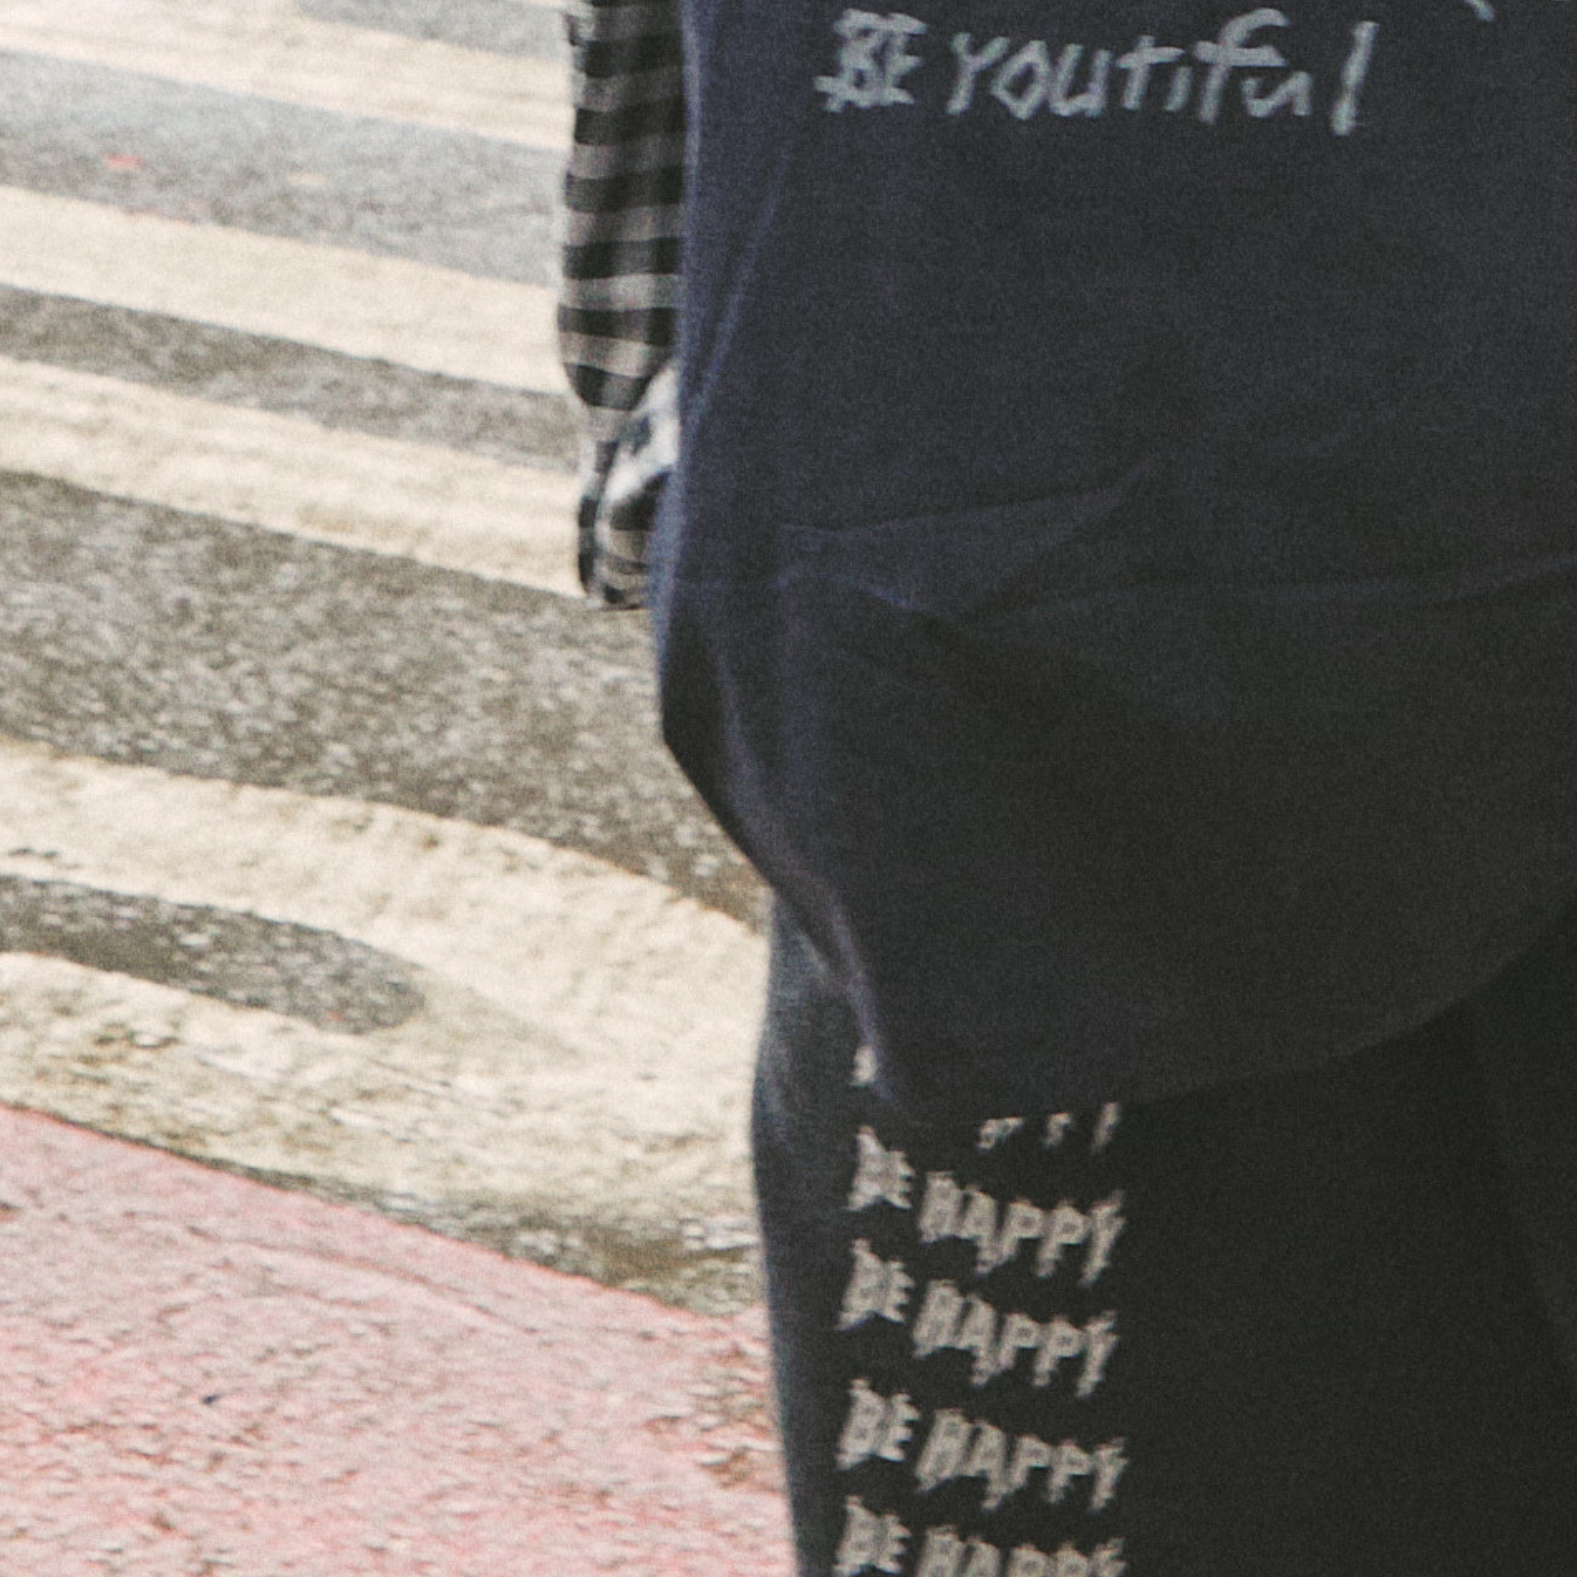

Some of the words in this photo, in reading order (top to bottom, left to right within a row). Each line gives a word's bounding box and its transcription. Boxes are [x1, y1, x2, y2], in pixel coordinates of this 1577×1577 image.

[845, 1124, 917, 1213] BE
[917, 1169, 1128, 1288] HAPPY
[833, 1236, 916, 1333] BE
[911, 1278, 1119, 1400] HAPPY
[835, 1375, 921, 1472] BE
[914, 1406, 1130, 1514] HAPPY
[831, 1493, 912, 1577] BE
